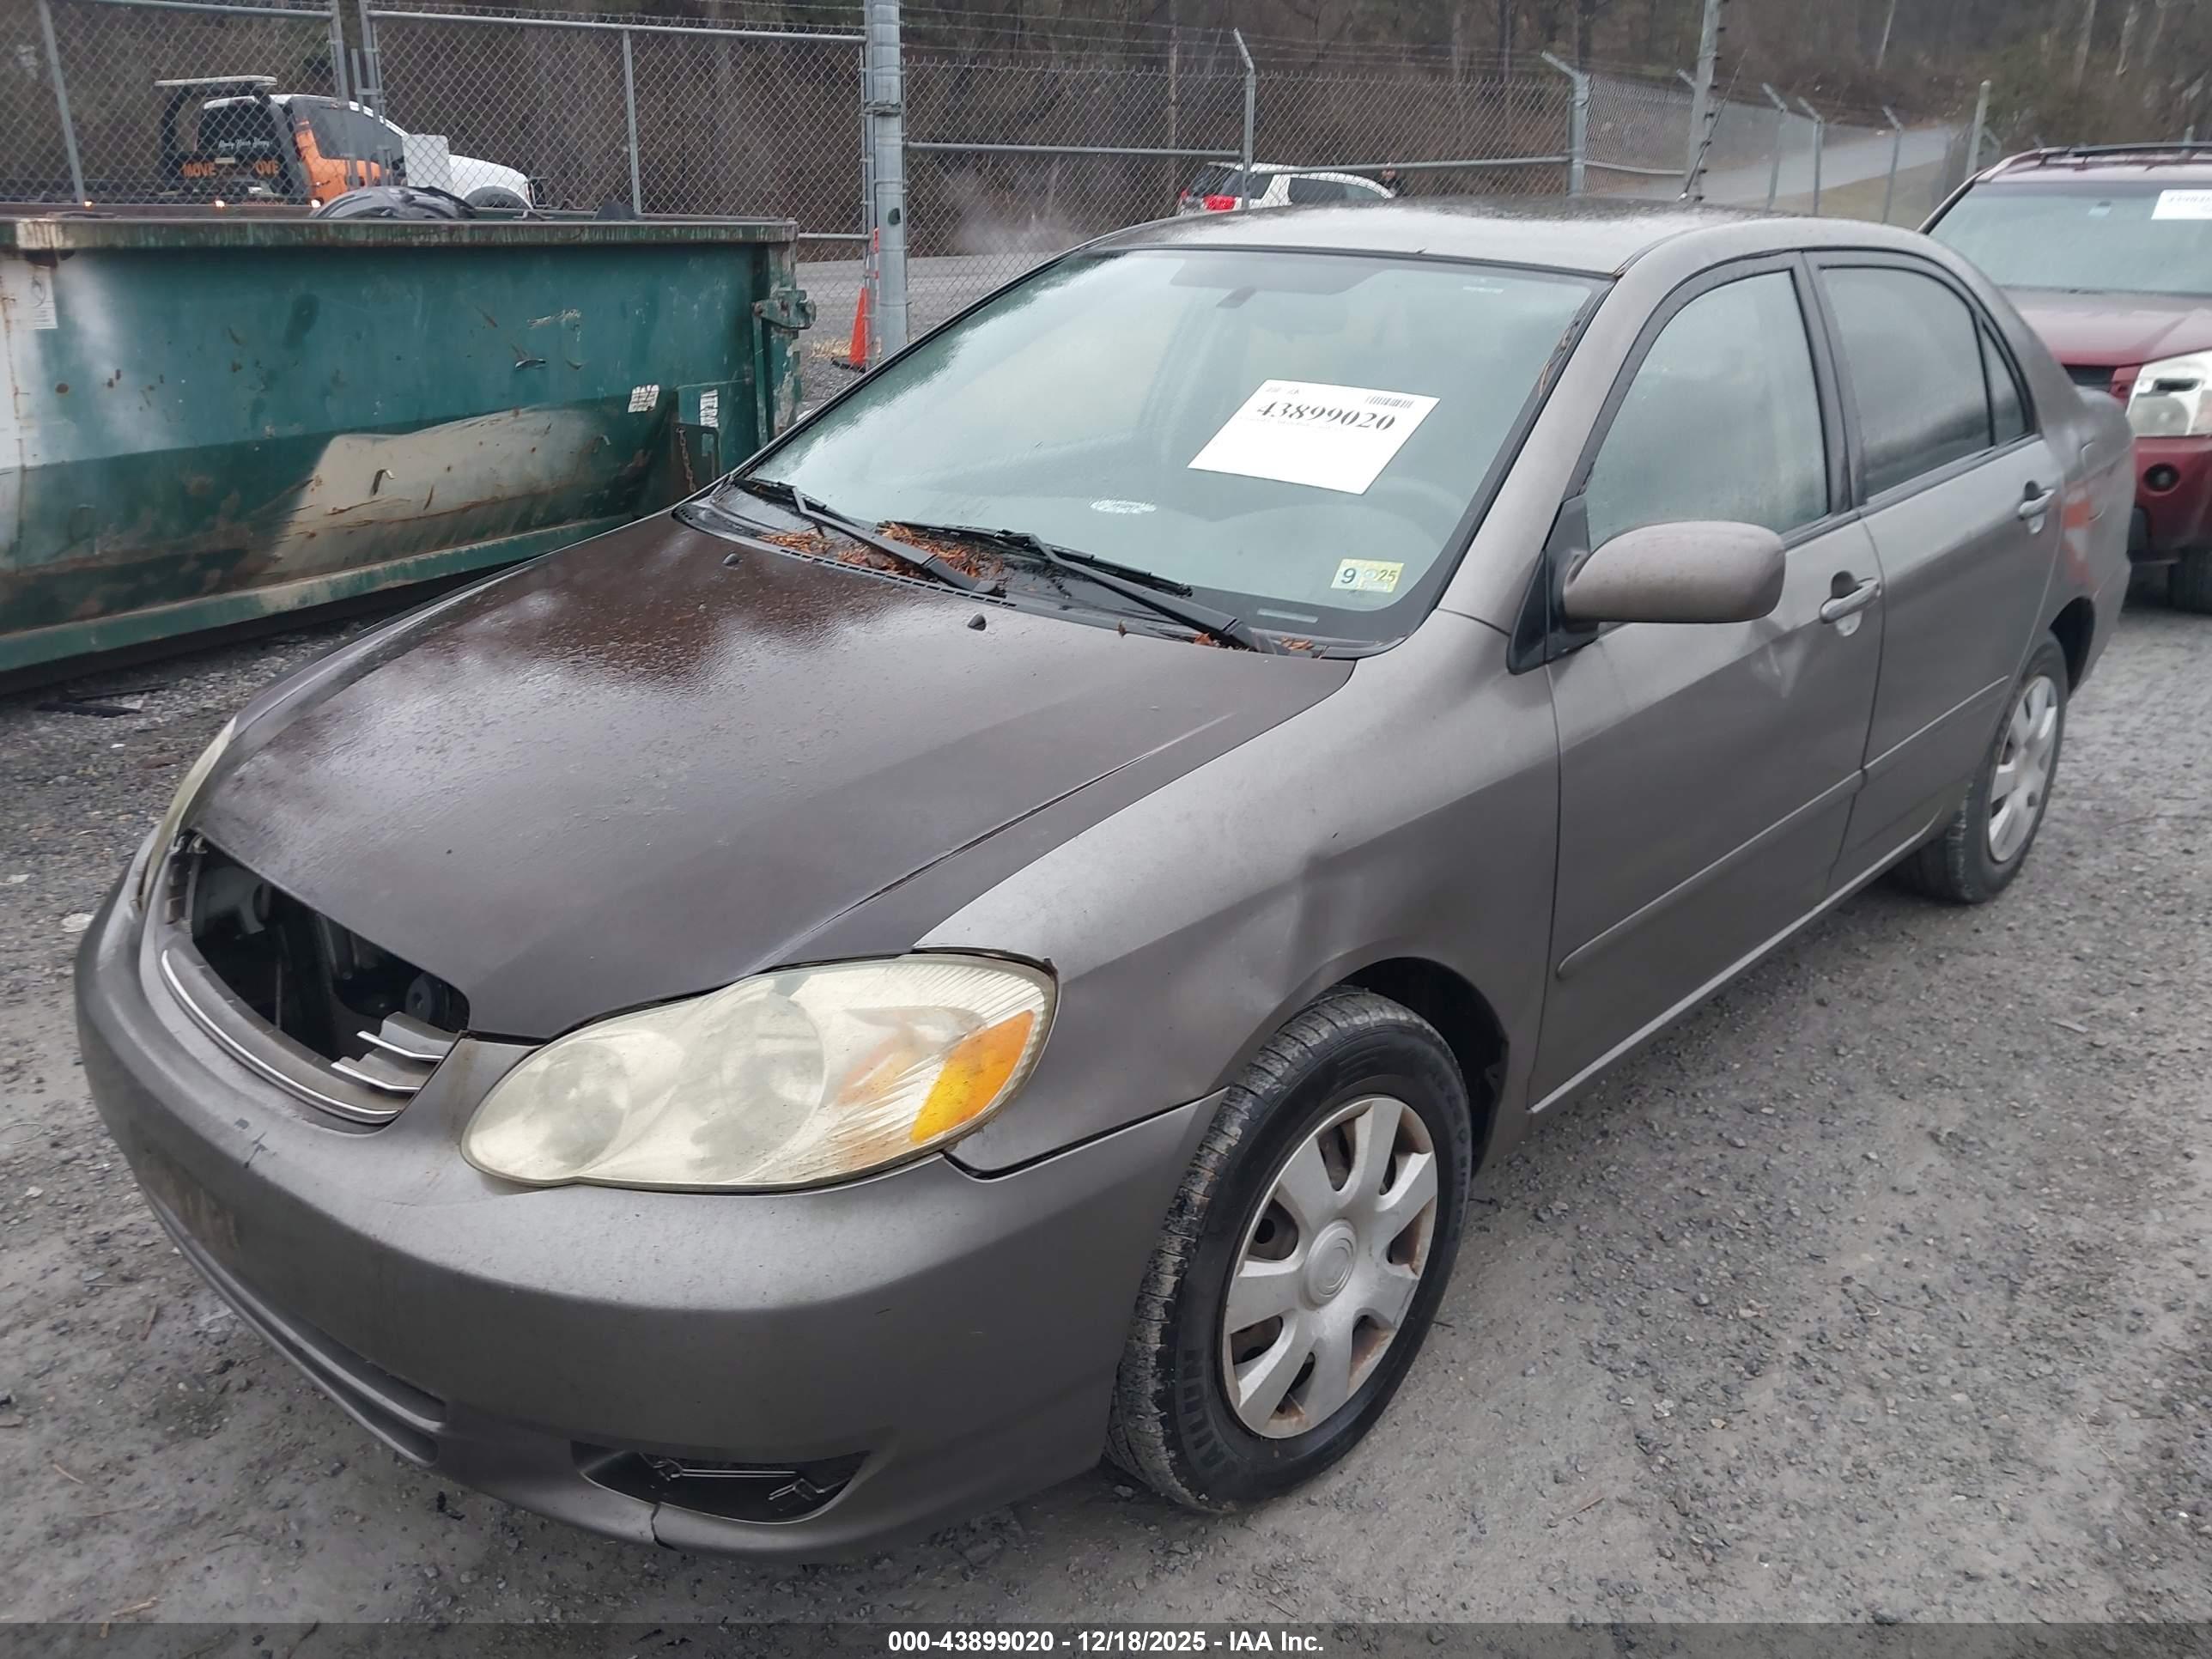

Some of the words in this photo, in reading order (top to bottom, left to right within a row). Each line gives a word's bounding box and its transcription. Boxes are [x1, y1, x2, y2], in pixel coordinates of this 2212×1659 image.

[184, 161, 216, 177] MOVE
[1256, 401, 1396, 430] 43899020
[1340, 568, 1357, 584] 9
[1376, 569, 1398, 582] 25
